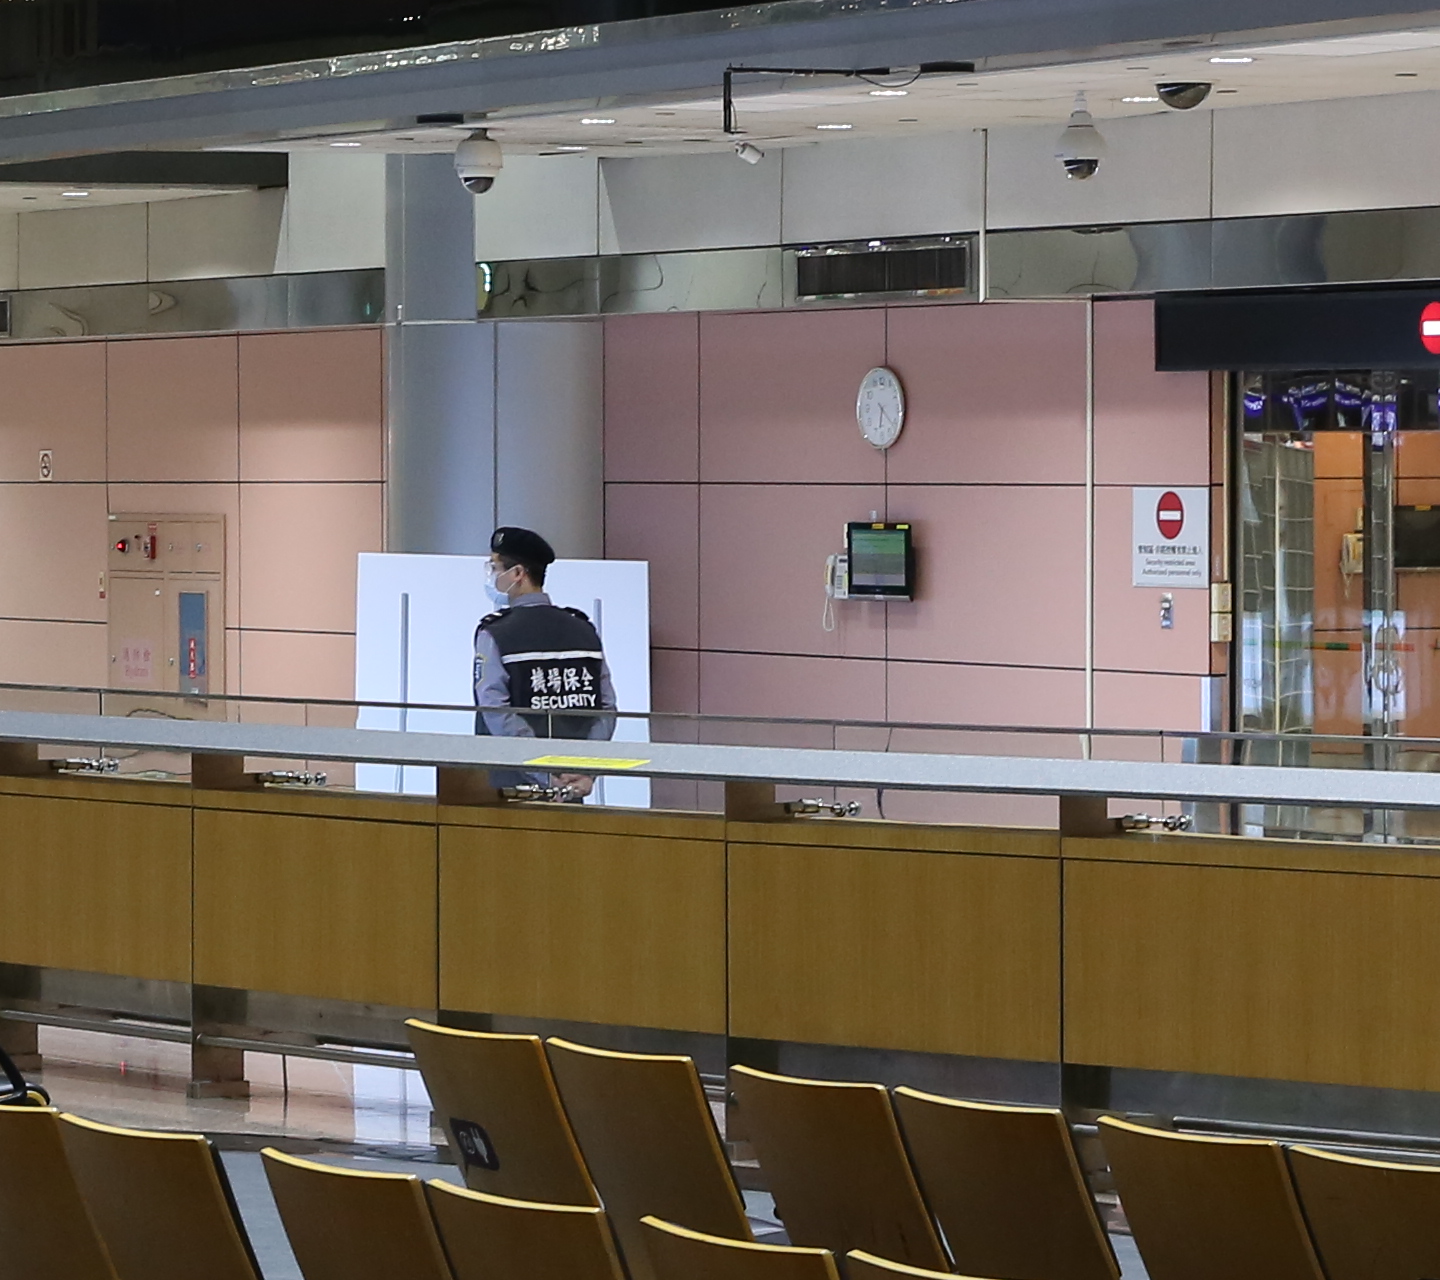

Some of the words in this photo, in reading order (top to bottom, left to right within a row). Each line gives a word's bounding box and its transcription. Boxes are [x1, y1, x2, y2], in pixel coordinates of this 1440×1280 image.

[530, 667, 594, 692] 機場保全
[530, 693, 597, 710] SECURITY
